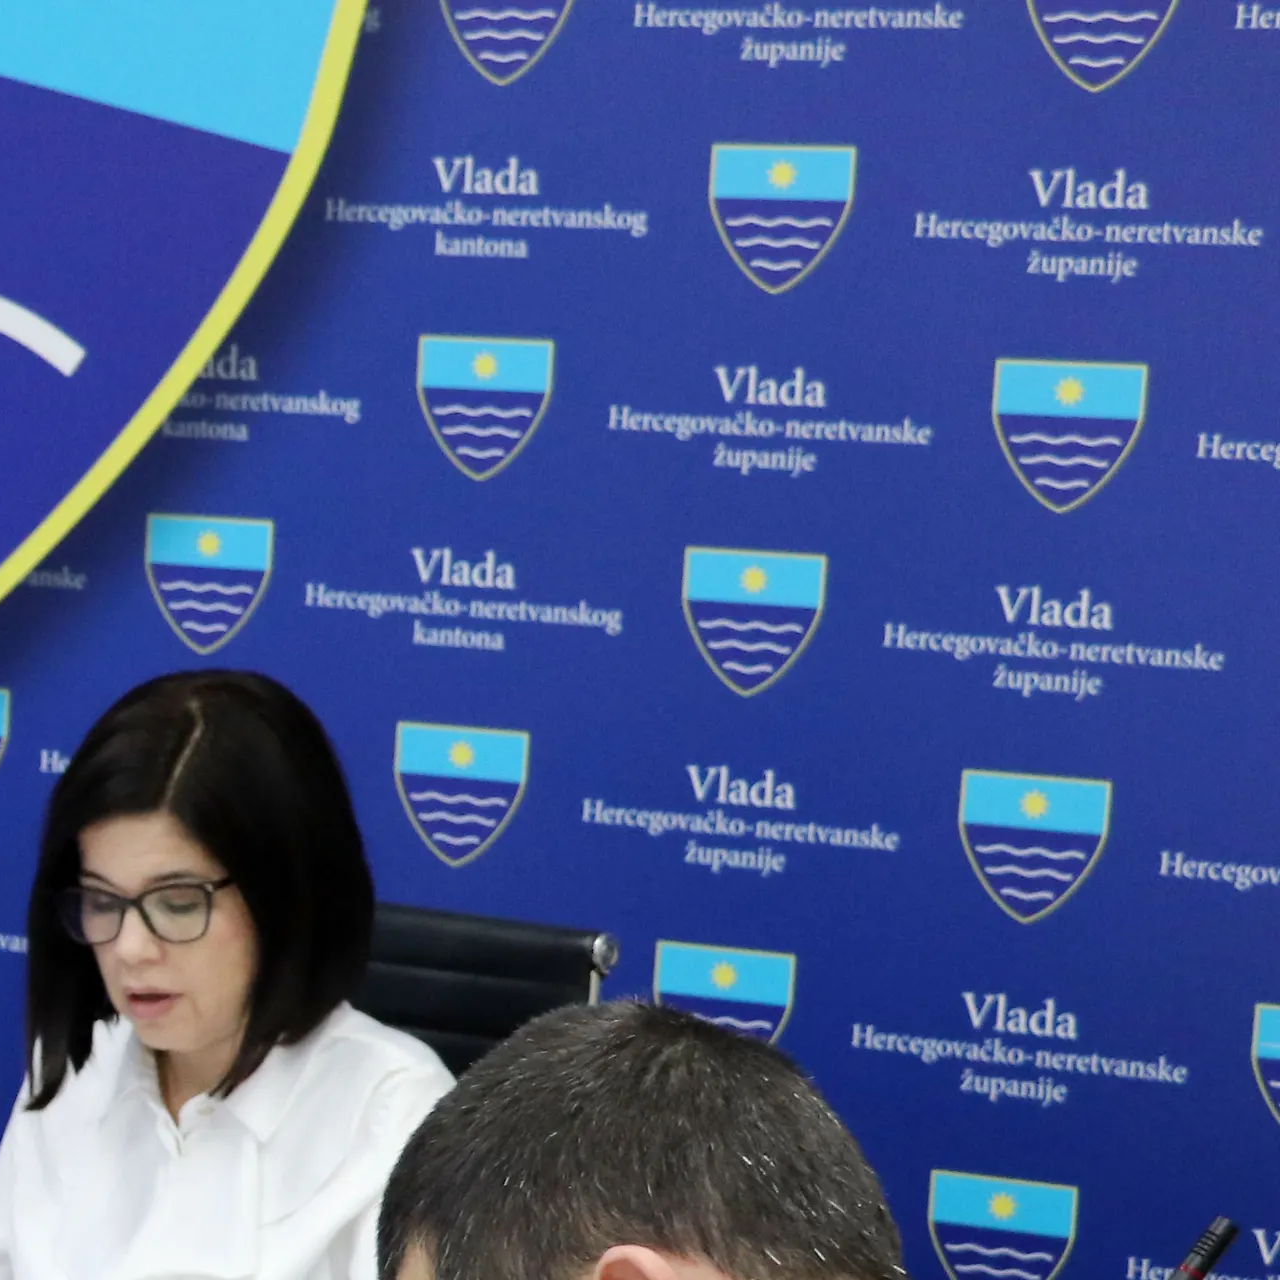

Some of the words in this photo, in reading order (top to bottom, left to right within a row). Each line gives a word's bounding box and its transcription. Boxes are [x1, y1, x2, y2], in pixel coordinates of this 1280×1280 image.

[633, 1, 965, 35] Hercegovačko-neretvanske
[739, 36, 847, 69] županije
[432, 154, 539, 196] Vlada
[1028, 167, 1150, 210] Vlada
[324, 199, 648, 238] Hercegovačko-neretvanskog
[913, 211, 1264, 248] Hercegovačko-neretvanske
[434, 230, 529, 260] kantona
[1026, 249, 1139, 283] županije
[197, 344, 258, 381] ada
[714, 364, 826, 408] Vlada
[607, 403, 933, 446] Hercegovačko-neretvanske
[712, 441, 818, 477] županije
[411, 546, 516, 590] Vlada
[304, 582, 623, 634] Hercegovačko-neretvanskog
[995, 585, 1113, 631] Vlada
[412, 623, 505, 652] kantona
[882, 621, 1225, 673] Hercegovačko-neretvanske
[992, 663, 1103, 701] županije
[686, 764, 796, 810] Vlada
[581, 797, 901, 852] Hercegovačko-neretvanske
[683, 839, 787, 877] županije
[961, 991, 1078, 1042] Vlada
[850, 1023, 1188, 1085] Hercegovačko-neretvanske
[959, 1069, 1068, 1107] županije
